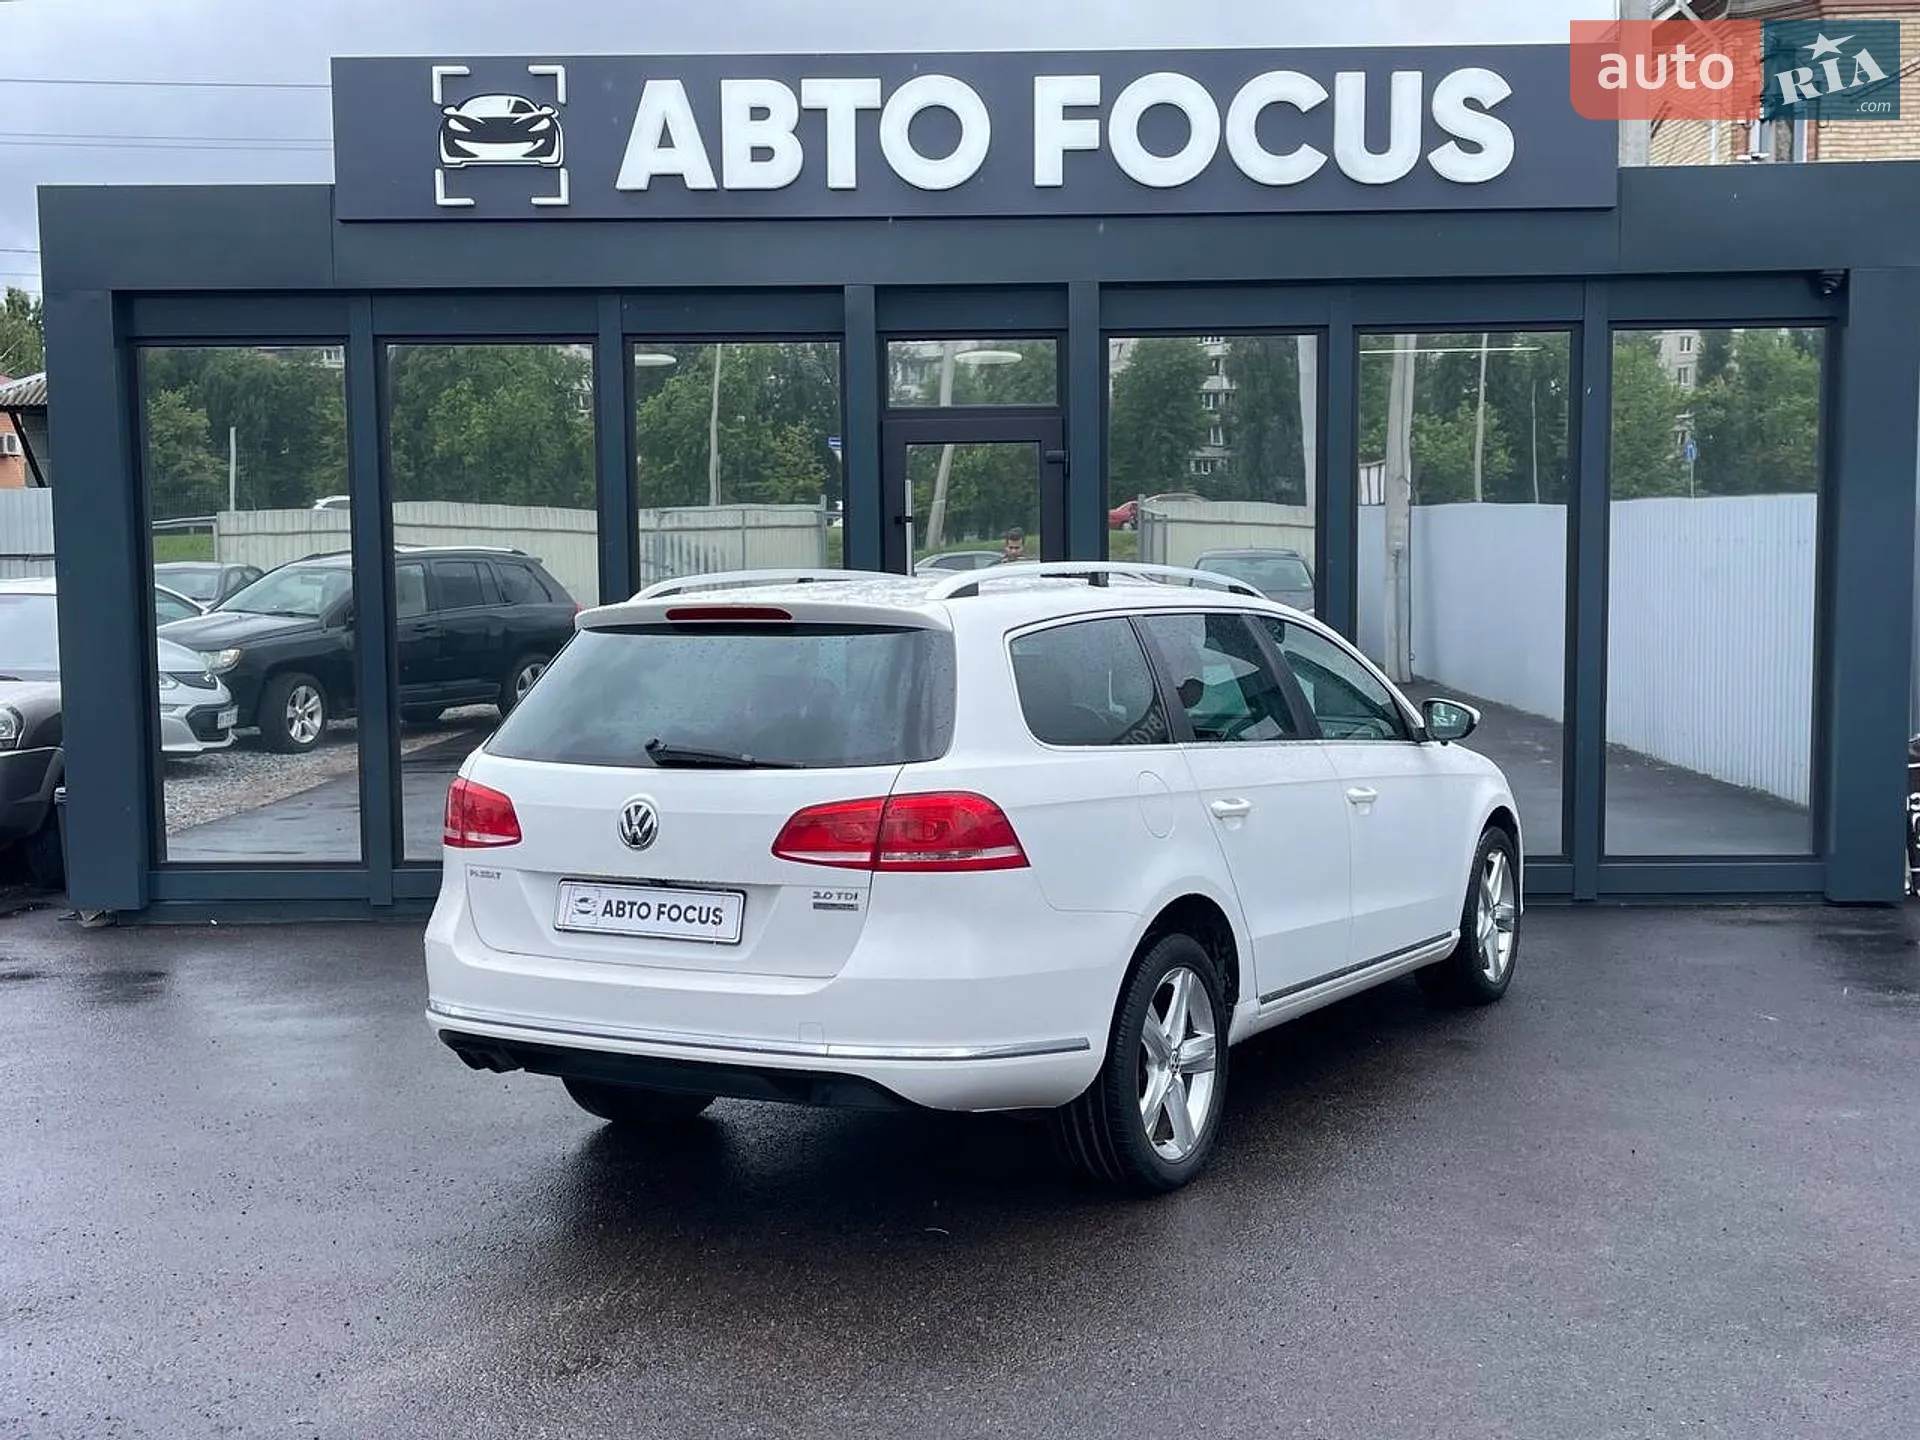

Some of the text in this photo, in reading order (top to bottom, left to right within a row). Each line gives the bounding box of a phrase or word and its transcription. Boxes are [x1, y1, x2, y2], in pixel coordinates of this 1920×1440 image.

[615, 67, 1516, 191] АВТО FOCUS
[812, 891, 858, 901] 2.0 TDI
[601, 899, 724, 927] АВТО FOCUS
